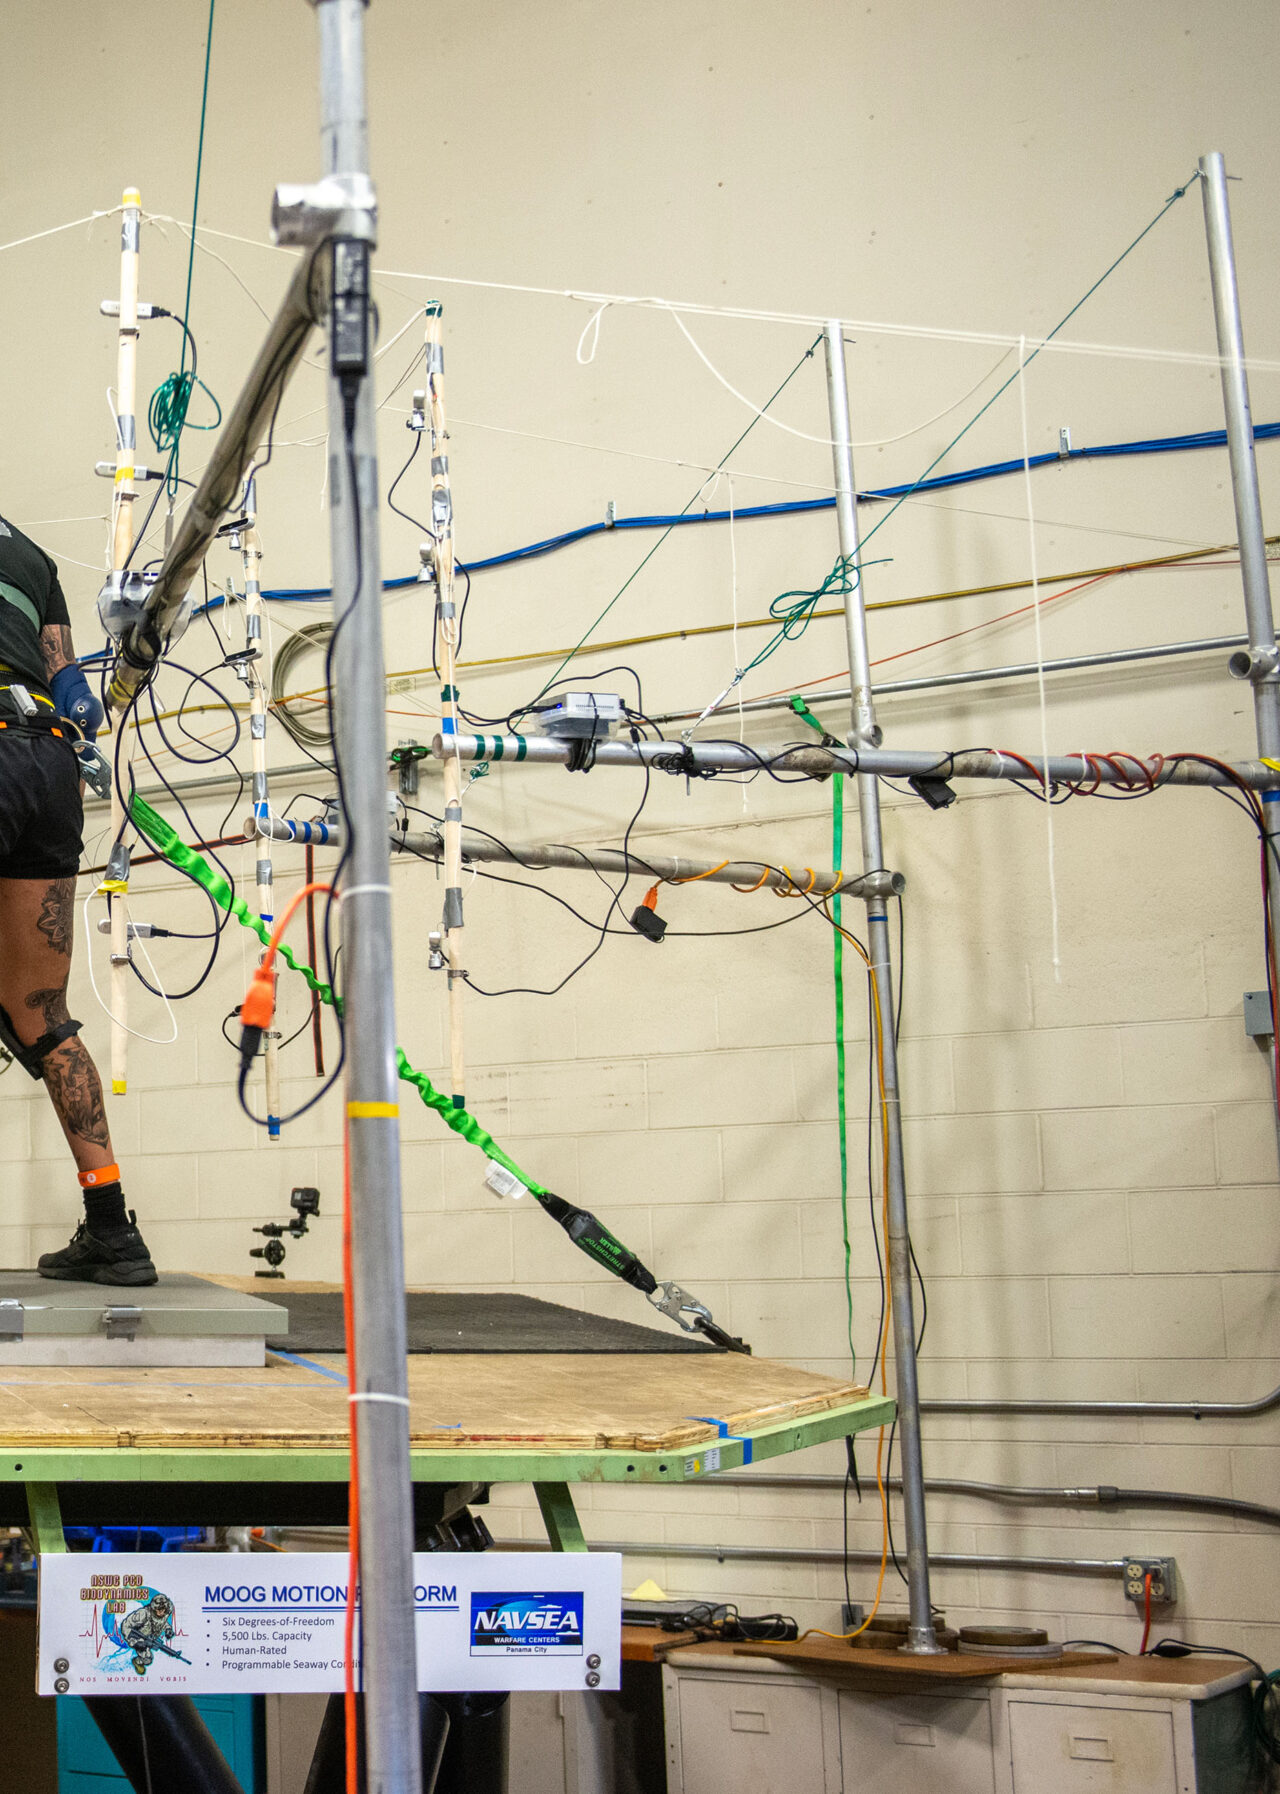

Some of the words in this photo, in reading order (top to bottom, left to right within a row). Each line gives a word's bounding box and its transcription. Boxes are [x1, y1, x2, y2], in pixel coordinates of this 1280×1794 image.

[91, 1575, 120, 1586] NSWC
[123, 1575, 143, 1586] PCD
[80, 1588, 149, 1600] BIODYNAMICS
[205, 1585, 266, 1603] MOOG
[272, 1585, 348, 1603] MOTION
[106, 1602, 126, 1613] LAB
[222, 1617, 236, 1626] Six
[238, 1617, 335, 1628] Degrees-of-Freedom
[474, 1611, 579, 1630] NAVSEA
[222, 1631, 249, 1642] 5,500
[251, 1631, 270, 1641] Lbs.
[272, 1631, 312, 1643] Capacity
[222, 1645, 287, 1655] Human-Rated
[222, 1659, 291, 1671] Programmable
[293, 1660, 329, 1671] Seaway
